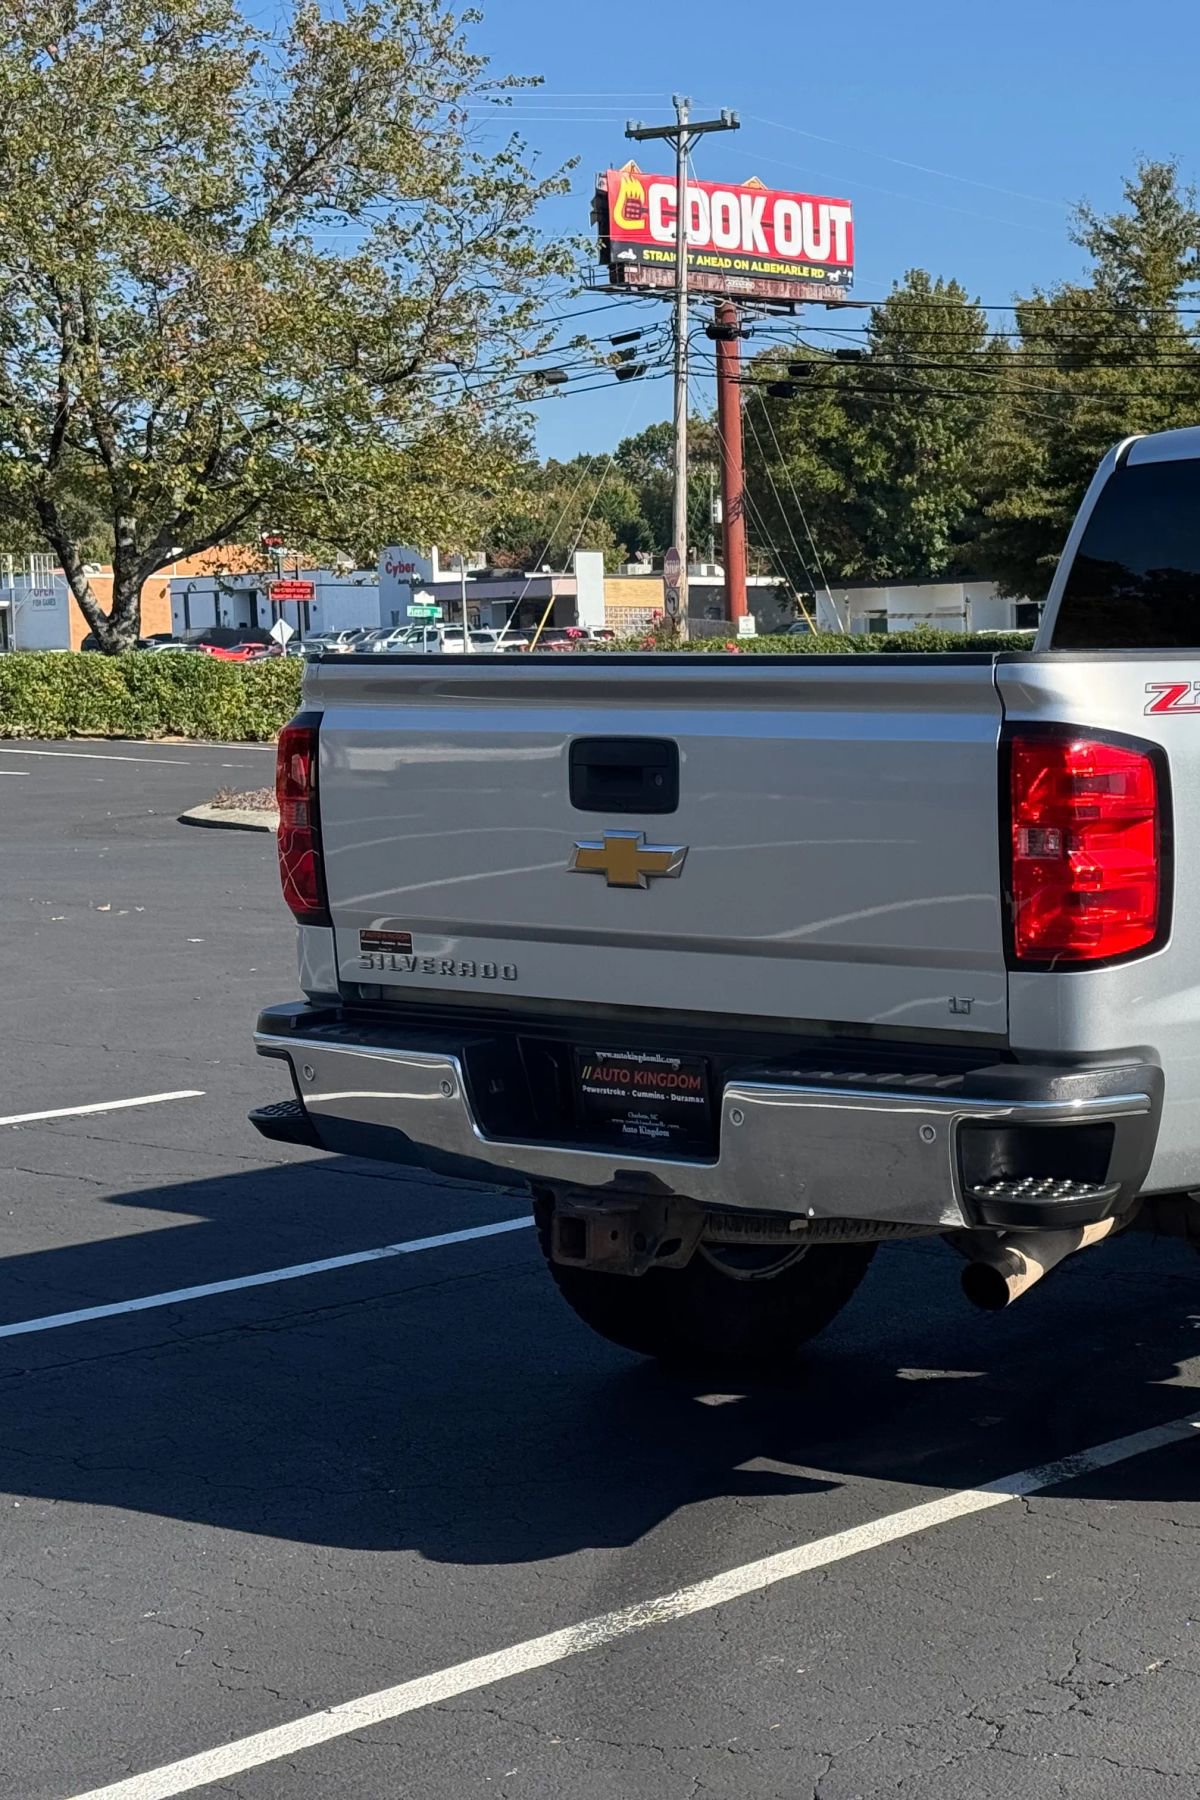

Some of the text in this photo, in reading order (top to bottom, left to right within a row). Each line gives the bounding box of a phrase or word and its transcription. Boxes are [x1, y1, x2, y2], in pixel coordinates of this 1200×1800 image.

[648, 183, 851, 262] COOK OUT
[643, 249, 825, 279] STRAIT AHEAD ON ALBEMARLE RD
[385, 561, 416, 578] Cyber
[358, 953, 518, 981] SILVERADO
[948, 996, 975, 1015] LT
[593, 1067, 701, 1089] AUTO KINGDOM
[582, 1085, 626, 1097] Powerstroke
[632, 1089, 665, 1100] Cummins
[671, 1093, 704, 1104] Duramax
